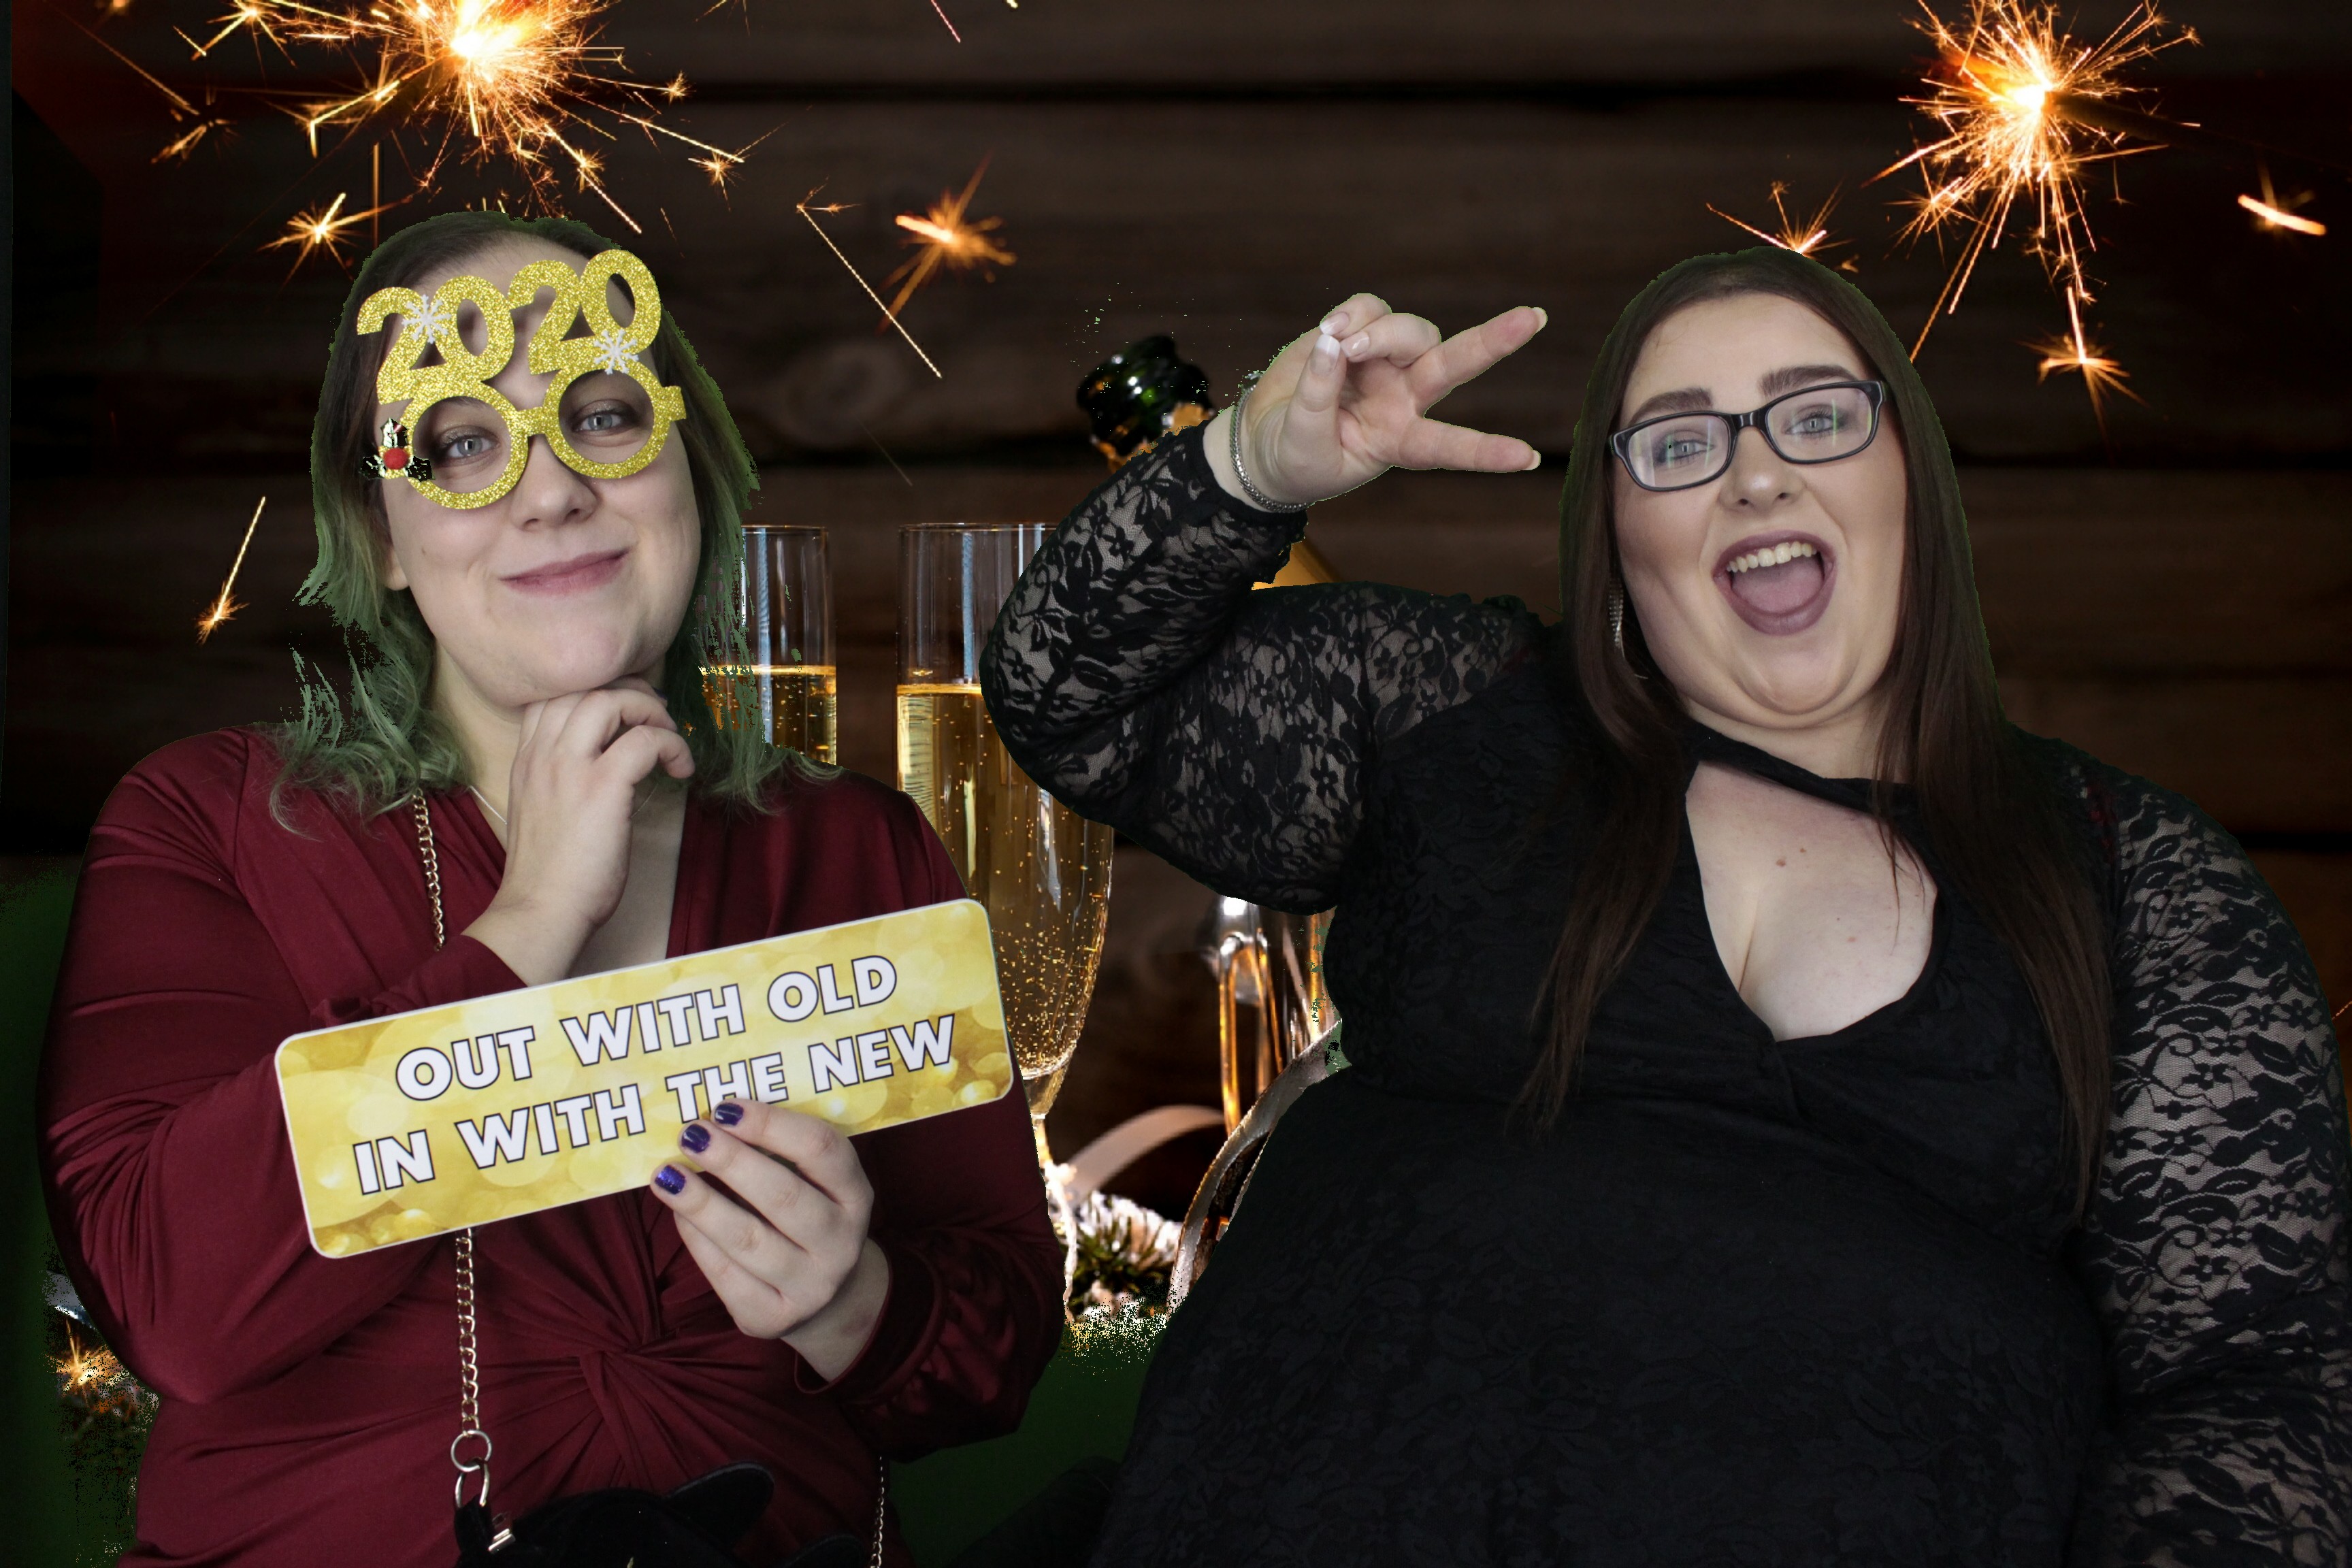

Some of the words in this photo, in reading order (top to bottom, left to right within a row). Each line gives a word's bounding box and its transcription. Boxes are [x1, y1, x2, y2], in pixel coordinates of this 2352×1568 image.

[357, 249, 662, 405] 2020
[352, 1129, 436, 1195] IN
[455, 1084, 644, 1169] WITH
[665, 1052, 788, 1122] THE
[808, 1014, 954, 1093] NEW
[395, 1026, 535, 1100] OUT
[560, 983, 746, 1066] WITH
[766, 954, 897, 1022] OLD
